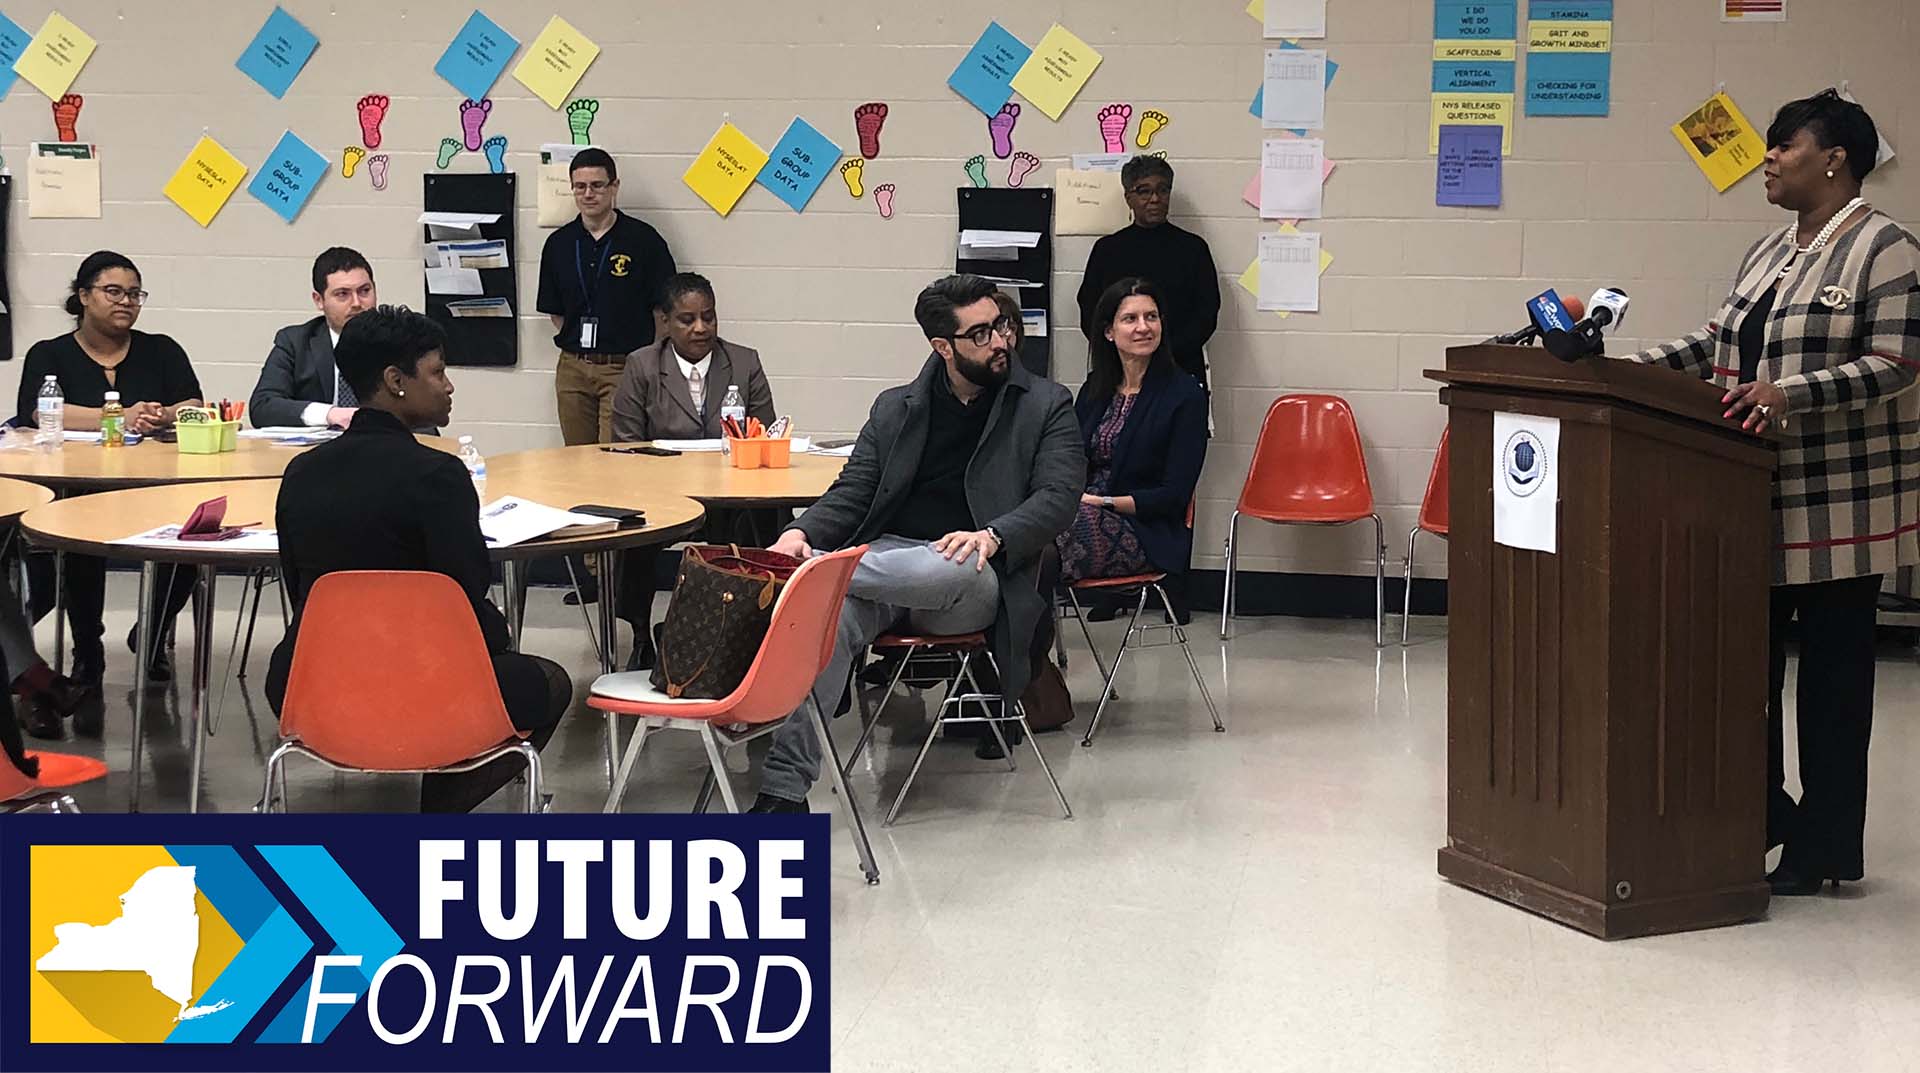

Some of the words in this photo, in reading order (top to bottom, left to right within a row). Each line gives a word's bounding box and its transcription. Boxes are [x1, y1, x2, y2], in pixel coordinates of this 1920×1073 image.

[1478, 27, 1490, 35] DO
[1446, 48, 1501, 57] SCAFFOLDING
[1530, 40, 1566, 48] GROWTH
[1568, 40, 1607, 48] MINDSET
[1442, 102, 1459, 110] NYS
[1461, 102, 1501, 110] RELEASED
[1447, 112, 1496, 120] QUESTIONS
[792, 147, 813, 165] SUB-
[283, 160, 303, 178] SUB-
[716, 160, 734, 177] DATA
[781, 156, 810, 179] GROUP
[196, 172, 213, 188] DATA
[272, 168, 300, 192] GROUP
[773, 169, 799, 191] DATA
[266, 181, 290, 203] DATA
